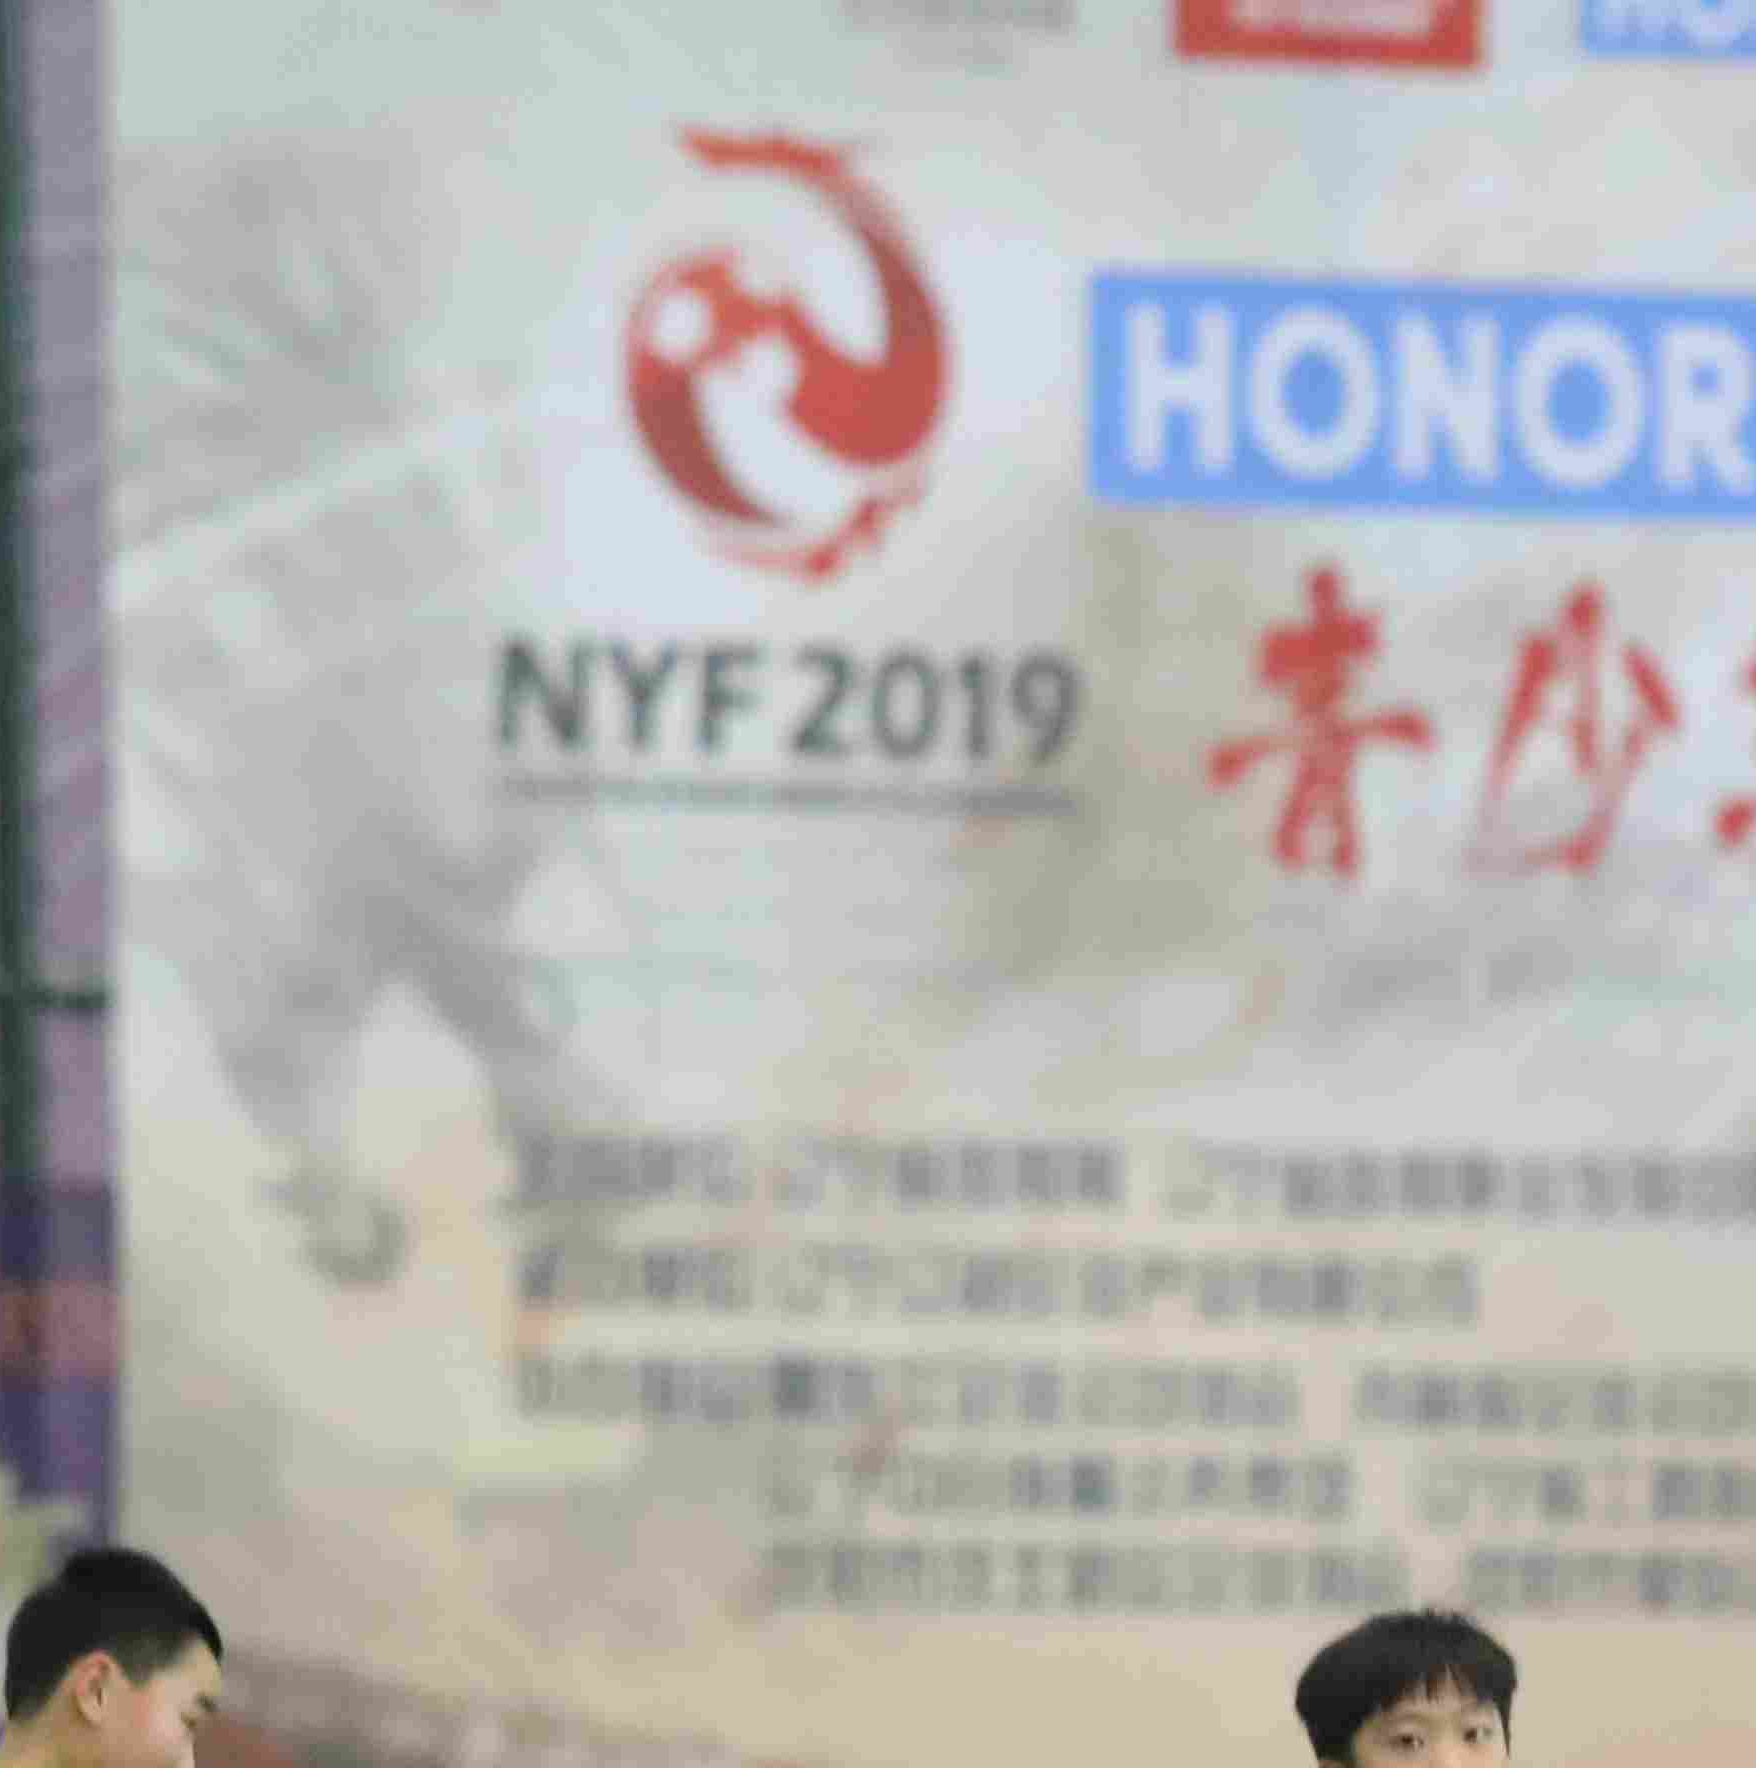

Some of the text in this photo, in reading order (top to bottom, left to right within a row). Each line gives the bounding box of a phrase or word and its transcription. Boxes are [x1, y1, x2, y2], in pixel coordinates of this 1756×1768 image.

[1121, 302, 1756, 492] HONOR
[493, 633, 1083, 766] NYF 2019
